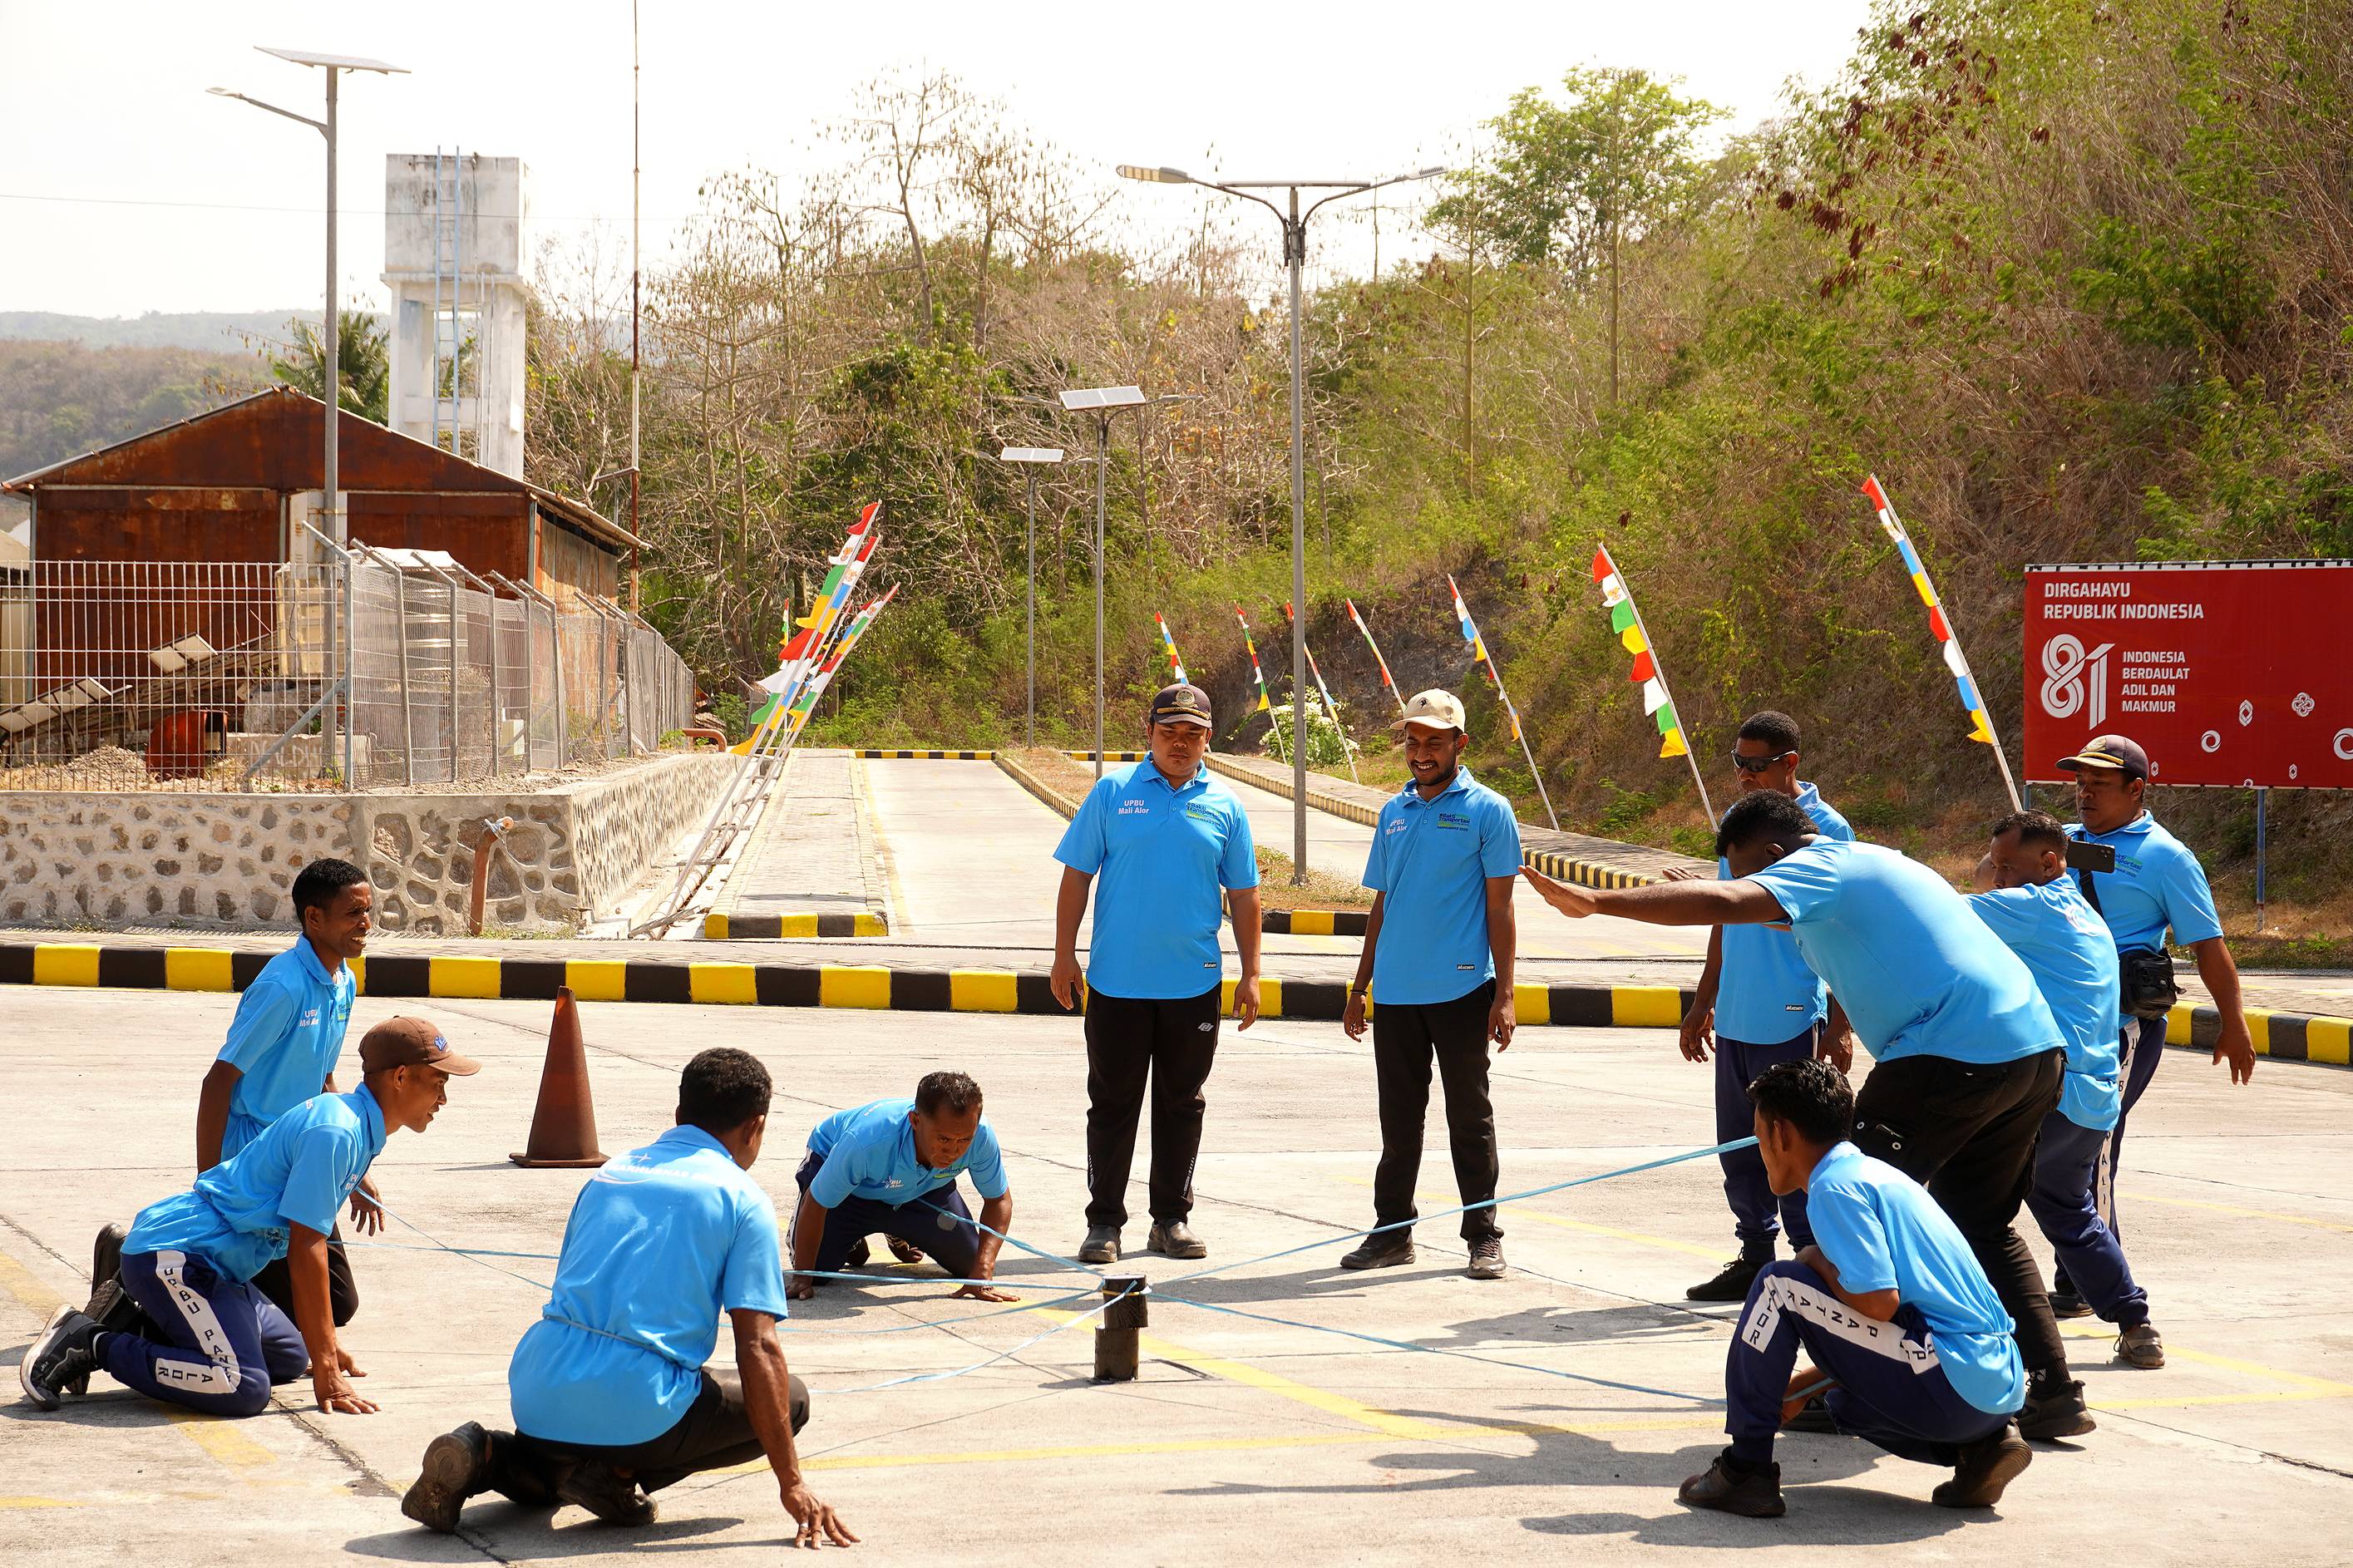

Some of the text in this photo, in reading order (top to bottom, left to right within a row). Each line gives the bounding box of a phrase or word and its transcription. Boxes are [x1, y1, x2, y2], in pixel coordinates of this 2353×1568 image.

[2044, 582, 2131, 598] DIRGAHAYU
[2043, 604, 2204, 619] REPUBLIK INDONESIA
[2123, 651, 2186, 663] INDONESIA
[2122, 668, 2190, 680] BERDAULAT
[2121, 684, 2175, 696] ADIL DAN
[2122, 701, 2176, 713] MAKMUR
[158, 1366, 214, 1384] ALOR
